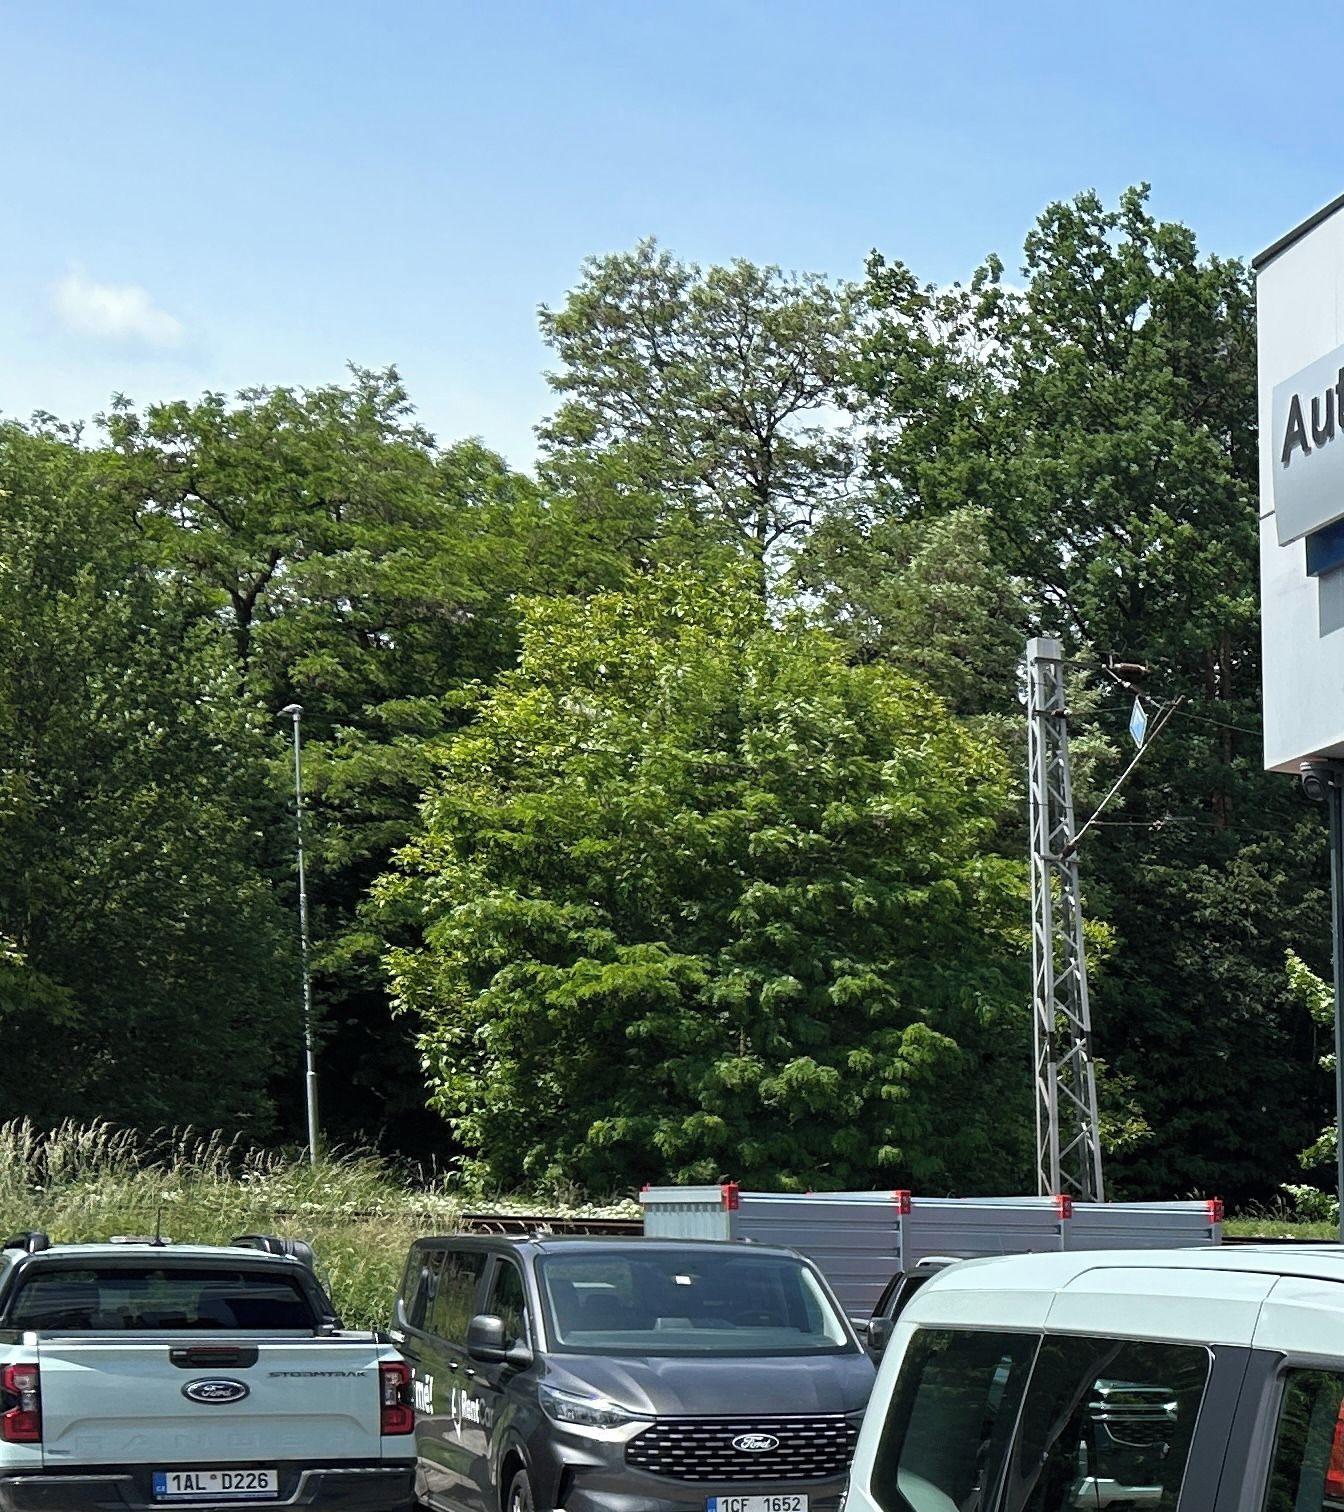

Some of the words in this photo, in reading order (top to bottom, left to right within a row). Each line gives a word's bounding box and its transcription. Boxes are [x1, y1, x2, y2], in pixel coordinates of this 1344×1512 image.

[267, 1370, 368, 1378] STORMTRAK
[172, 1473, 208, 1491] 1AL
[221, 1472, 269, 1490] D226
[721, 1498, 750, 1512] 1CF
[763, 1496, 802, 1512] 1652
